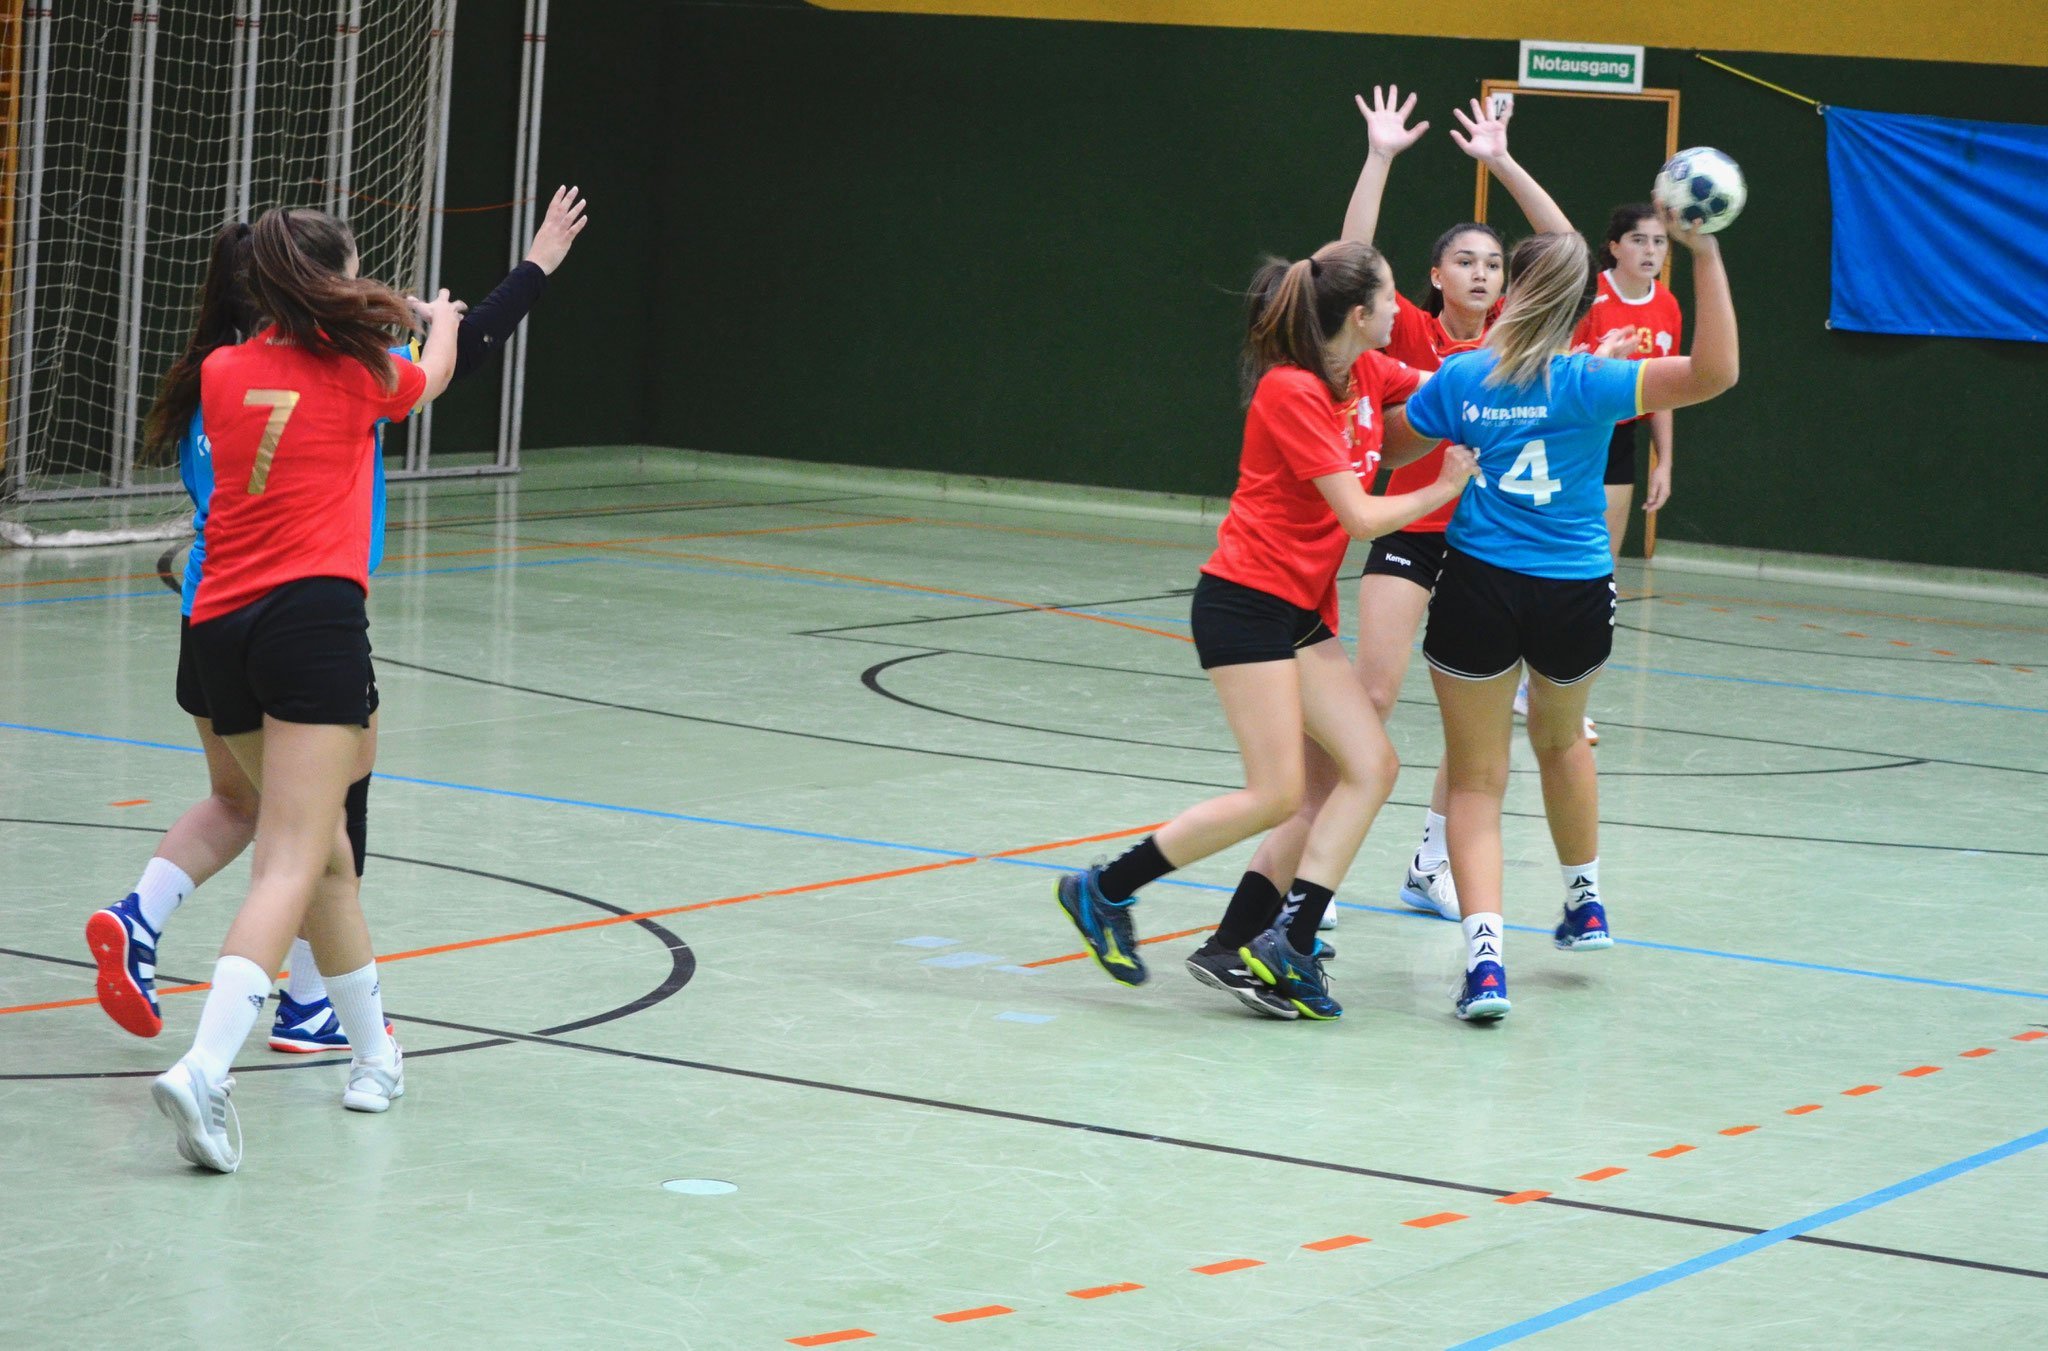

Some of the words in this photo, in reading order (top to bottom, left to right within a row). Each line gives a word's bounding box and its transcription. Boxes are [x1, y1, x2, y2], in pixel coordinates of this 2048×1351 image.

[1532, 55, 1630, 78] Notausgang
[1481, 406, 1548, 420] KEPINGR
[243, 389, 300, 495] 7
[1498, 439, 1562, 506] 4
[1385, 553, 1411, 567] Kempa
